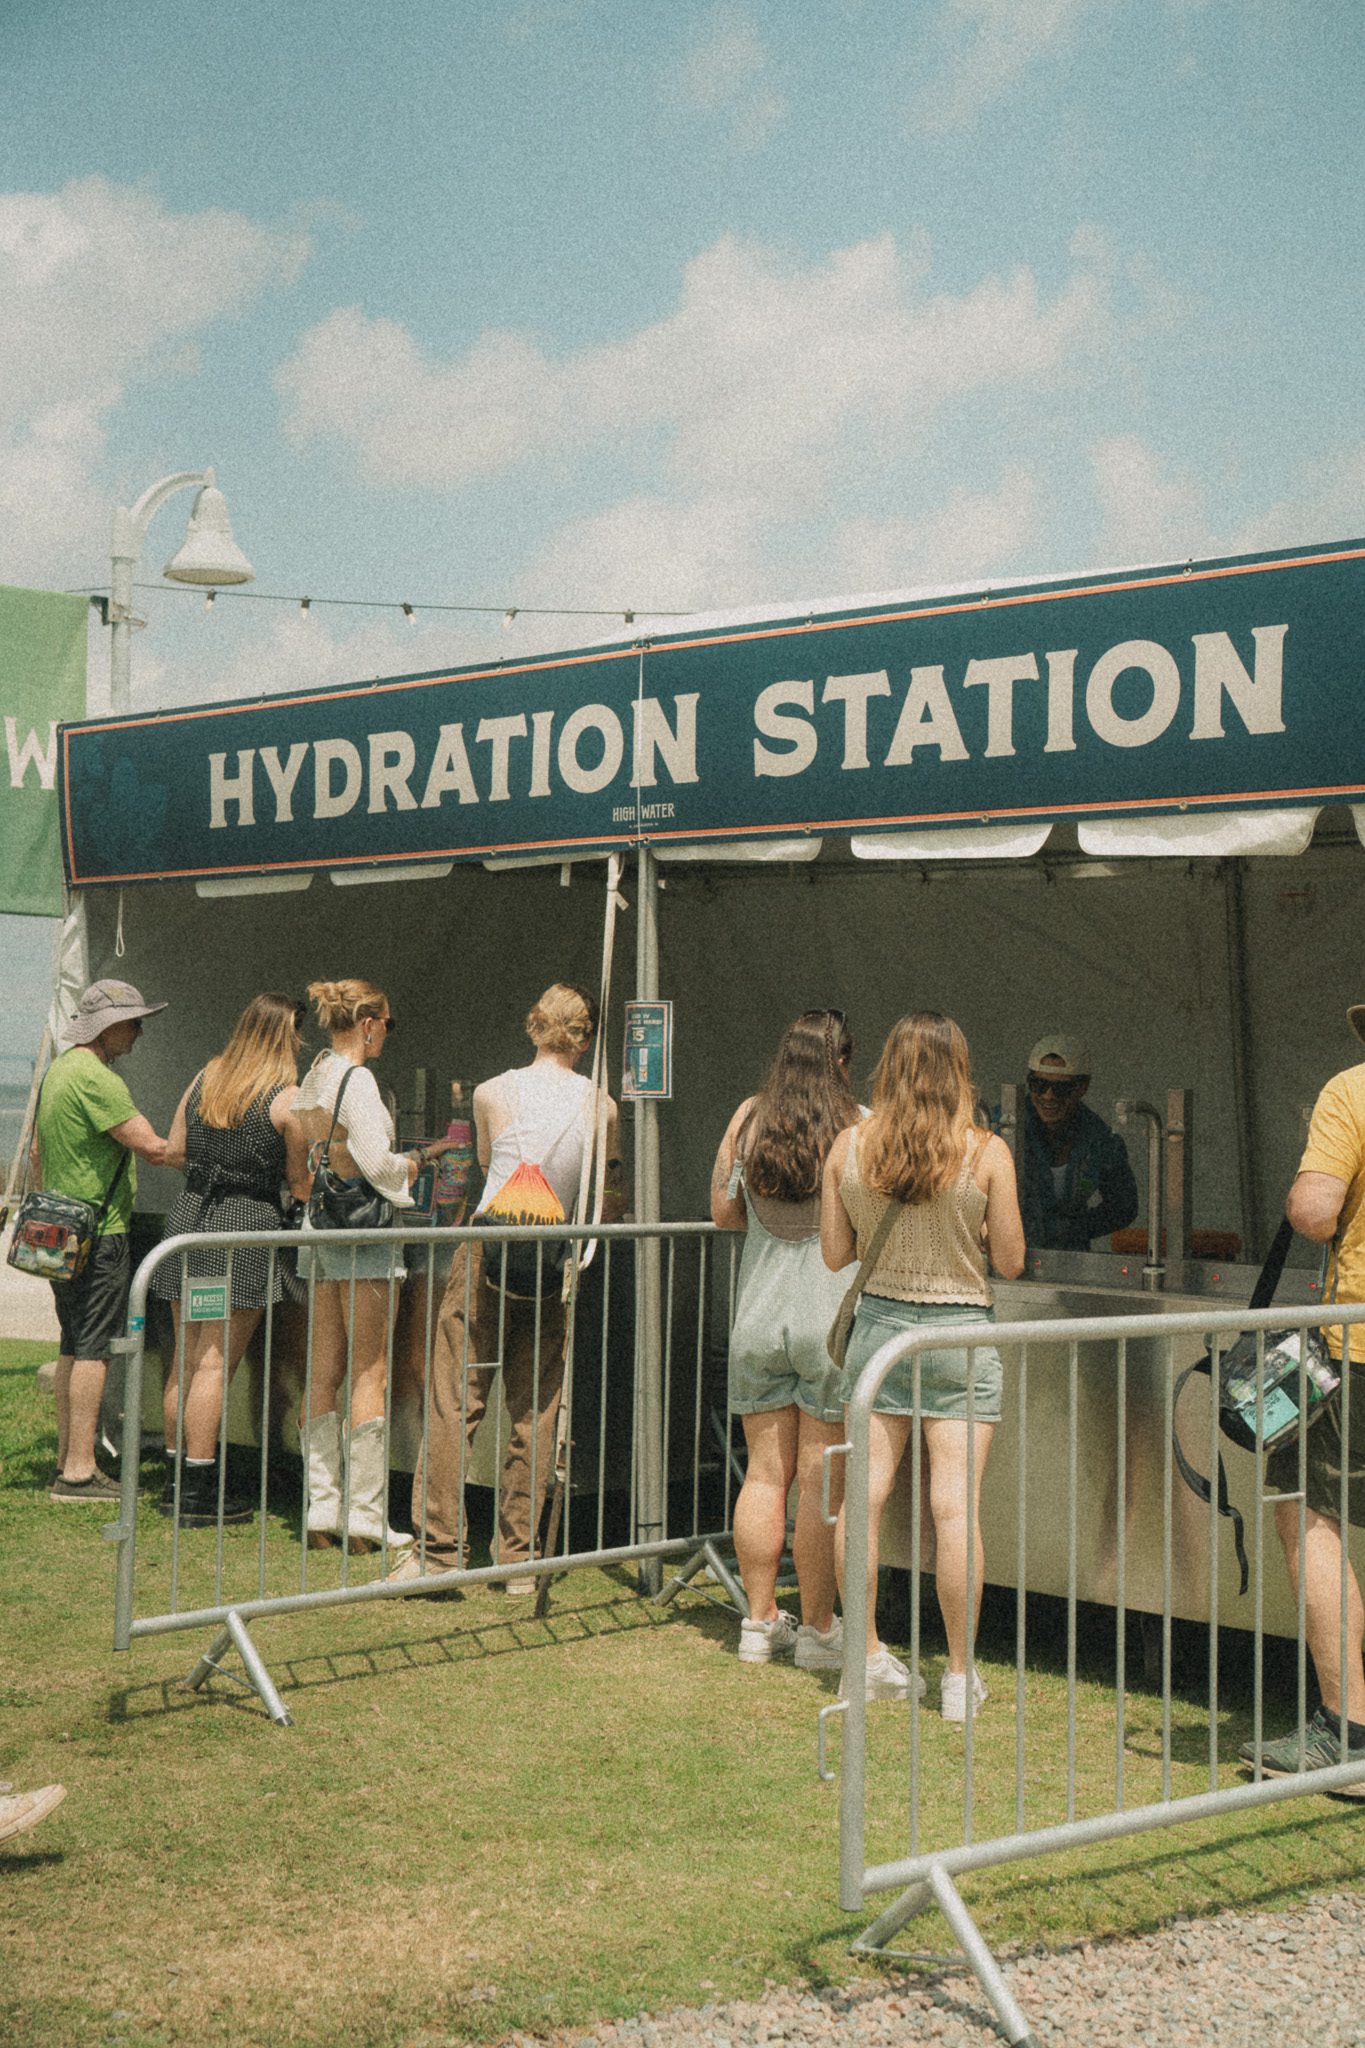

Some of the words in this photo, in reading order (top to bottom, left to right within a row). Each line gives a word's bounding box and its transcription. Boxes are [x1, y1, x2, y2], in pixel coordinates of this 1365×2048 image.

[207, 692, 702, 830] HYDRATION
[753, 623, 1290, 778] STATION
[612, 806, 636, 822] HIGH
[641, 803, 675, 819] WATER
